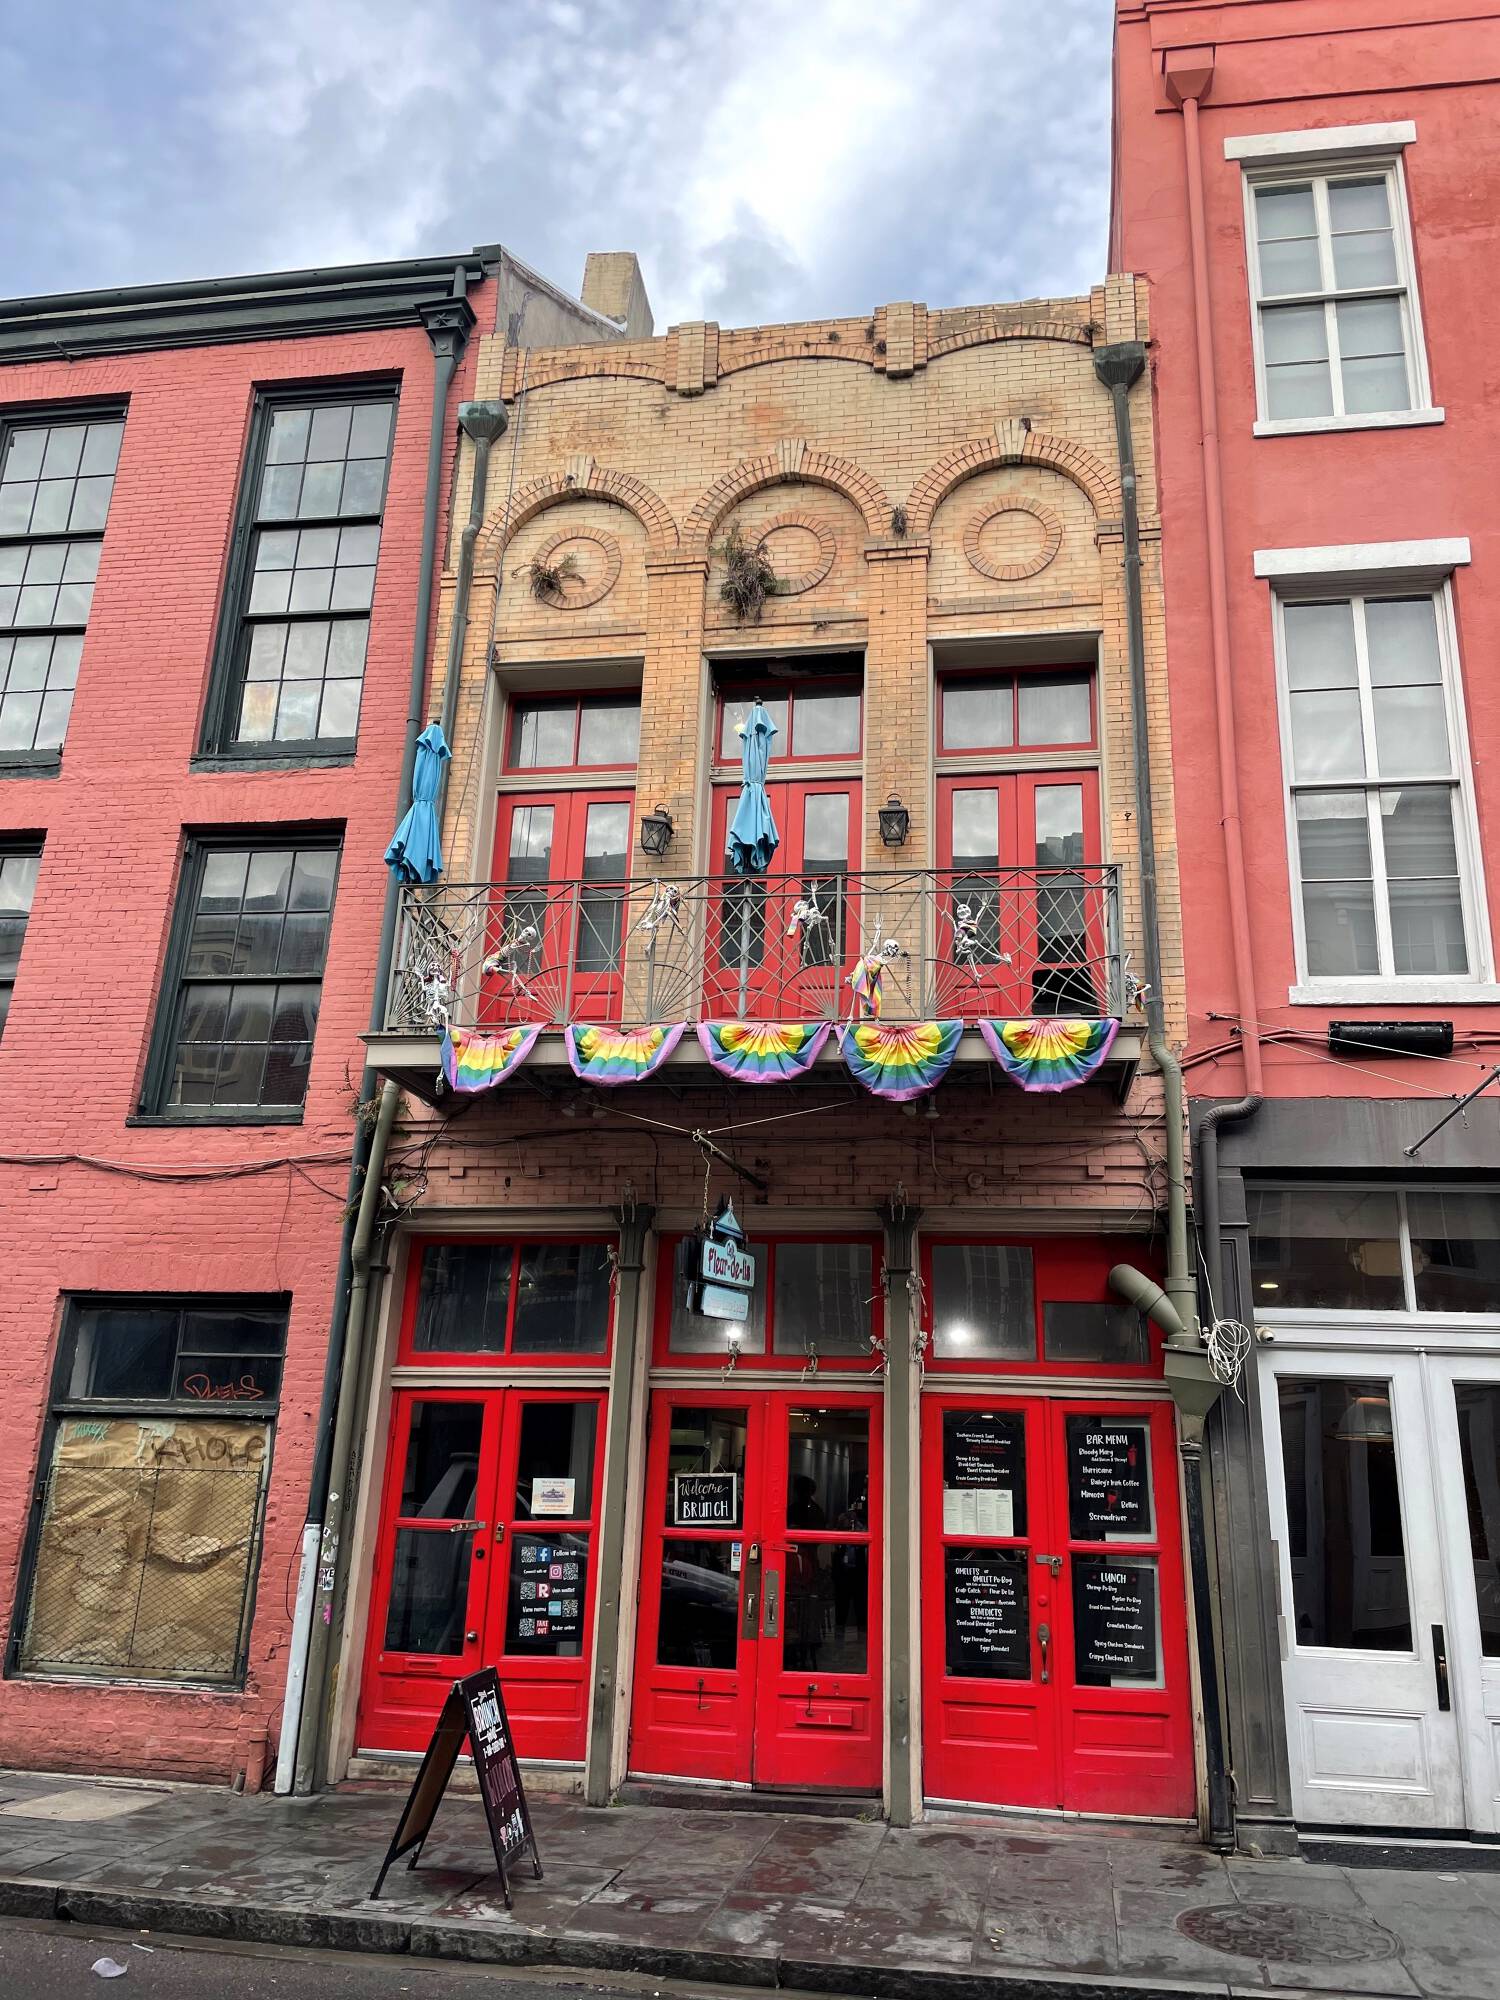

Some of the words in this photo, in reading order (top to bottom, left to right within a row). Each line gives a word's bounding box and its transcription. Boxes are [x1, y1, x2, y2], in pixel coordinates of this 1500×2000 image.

[708, 1247, 751, 1282] Fleur-de-lis
[1086, 1434, 1104, 1445] BAR
[1105, 1434, 1128, 1446] MENU
[1079, 1447, 1098, 1458] Bloody
[1098, 1448, 1114, 1458] Mary
[1082, 1465, 1113, 1474] Hurricane
[679, 1479, 729, 1497] Welcome
[1090, 1478, 1110, 1488] Bailey's
[1122, 1479, 1140, 1487] Coffee
[1080, 1489, 1105, 1499] Mimosa
[682, 1500, 729, 1519] BRUNCH
[1120, 1500, 1139, 1509] Bellini
[1088, 1511, 1128, 1522] Screwdriver
[552, 1549, 570, 1557] Follow
[955, 1567, 980, 1576] OMELETS
[972, 1575, 993, 1583] OMELET
[1100, 1572, 1127, 1584] LUNCH
[1086, 1583, 1102, 1592] Shrimp
[1111, 1595, 1126, 1604] Oyster
[970, 1606, 1003, 1618] BENEDICTS
[537, 1627, 547, 1635] OUT
[961, 1635, 972, 1644] Eggs
[1094, 1639, 1108, 1649] Spicy
[1107, 1640, 1125, 1648] Chicken
[1123, 1642, 1145, 1650] Sandwich
[980, 1644, 991, 1653] Eggs
[990, 1644, 1010, 1652] Benedict
[1088, 1652, 1105, 1663] Crispy
[1104, 1653, 1124, 1662] Chicken
[1123, 1655, 1134, 1663] BLT
